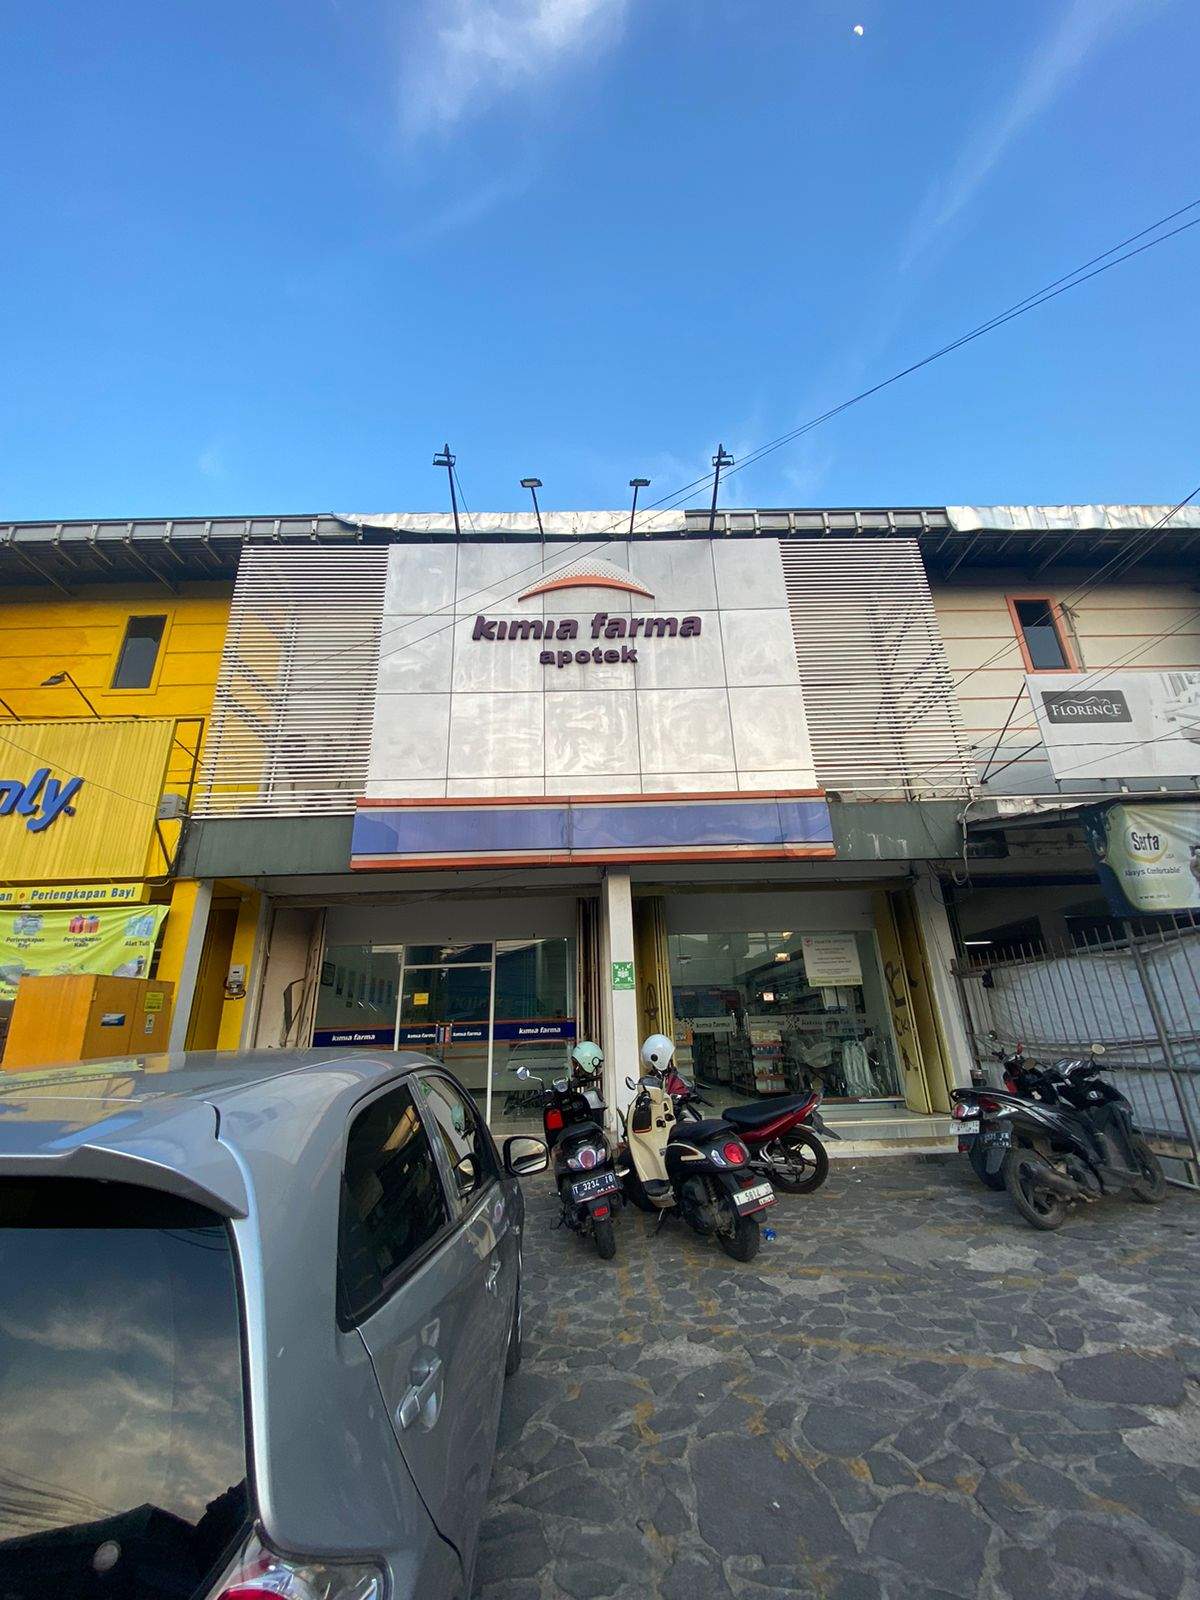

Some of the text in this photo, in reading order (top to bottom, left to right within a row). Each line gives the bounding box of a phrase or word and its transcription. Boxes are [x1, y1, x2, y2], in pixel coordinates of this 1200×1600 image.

[590, 612, 701, 639] farma
[539, 645, 638, 668] apotek
[1050, 703, 1122, 715] FLORENCE
[1131, 831, 1160, 851] Serta
[31, 888, 107, 901] Perlengkapan
[111, 887, 136, 900] Bayi
[540, 1026, 561, 1034] farma
